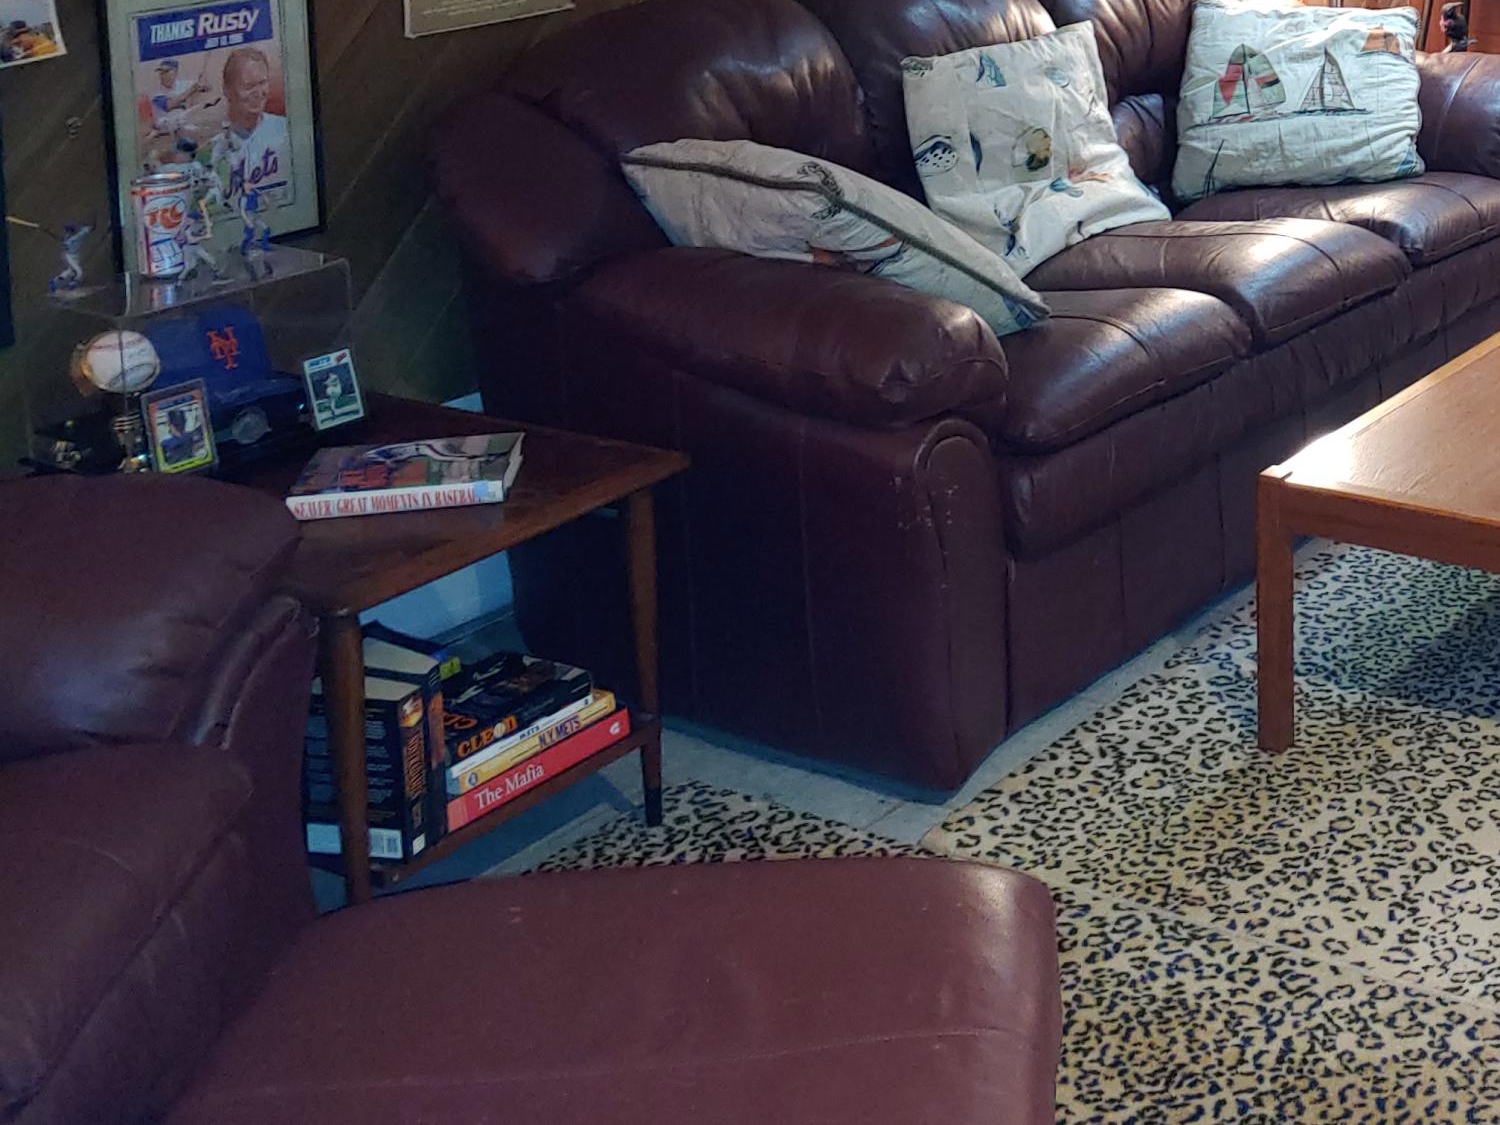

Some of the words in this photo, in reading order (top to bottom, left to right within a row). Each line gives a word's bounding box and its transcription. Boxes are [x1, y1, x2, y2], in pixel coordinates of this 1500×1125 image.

[150, 18, 195, 44] THANKS
[196, 6, 261, 37] Rusty
[336, 496, 367, 514] GREAT
[371, 492, 419, 510] MOMENTS
[434, 486, 482, 503] BASEBA
[474, 786, 503, 810] The
[504, 762, 545, 796] Mafia
